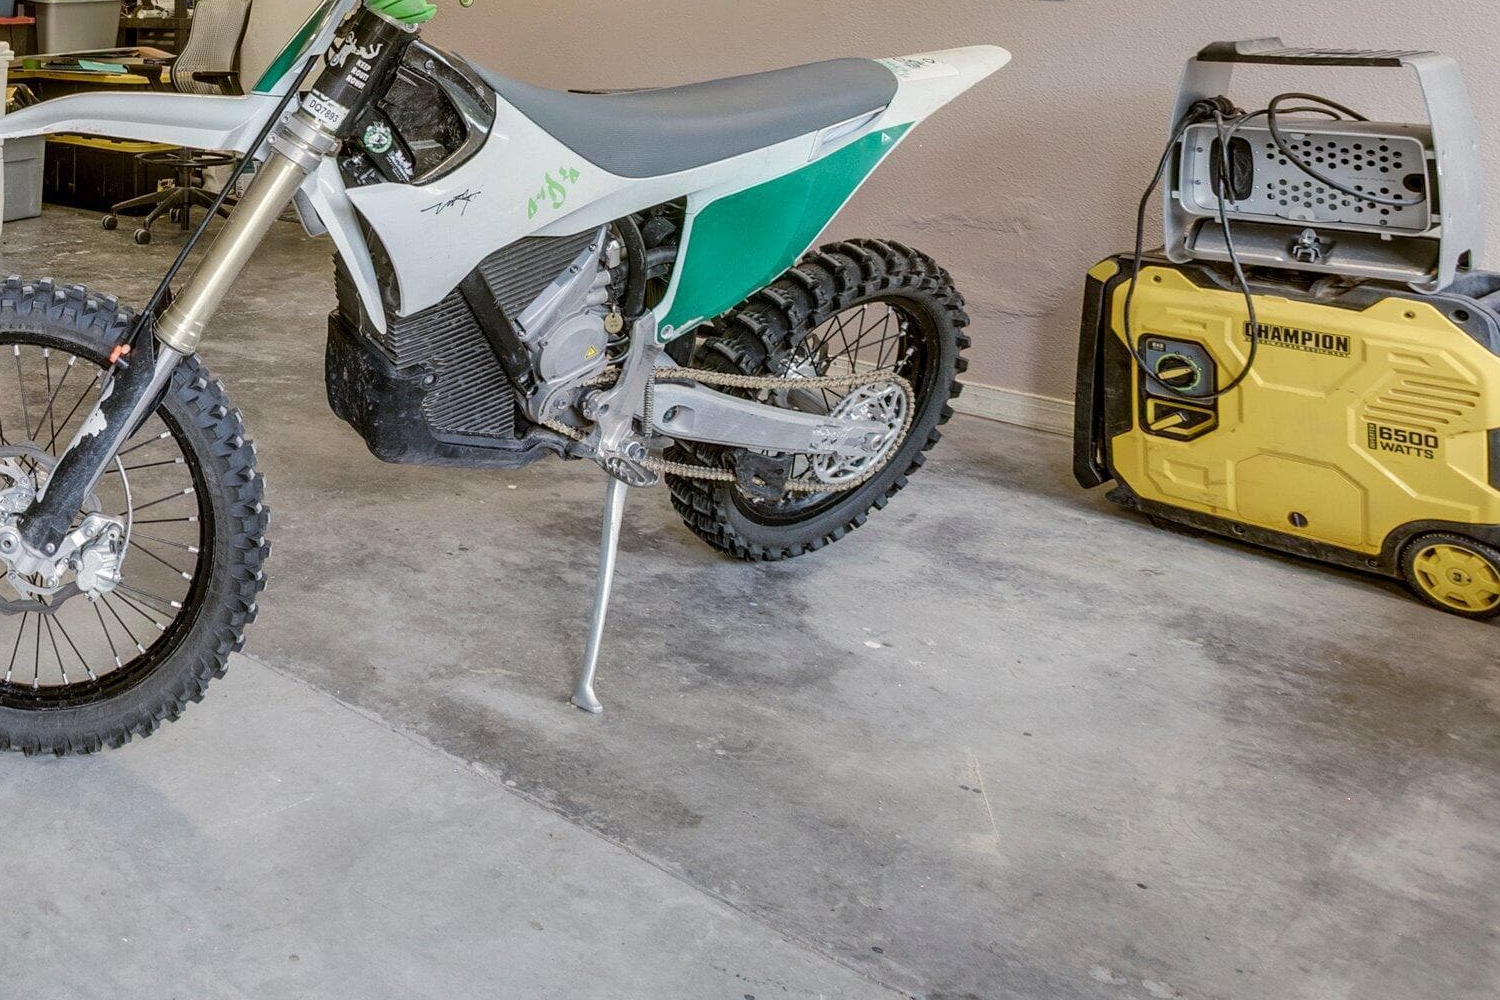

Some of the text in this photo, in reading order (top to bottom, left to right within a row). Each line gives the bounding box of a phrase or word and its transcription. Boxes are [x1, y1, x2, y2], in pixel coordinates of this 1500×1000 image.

[355, 60, 372, 72] KEEP
[309, 99, 339, 123] DQ7893
[1245, 322, 1349, 352] CHAMPION
[1379, 426, 1439, 449] 6500
[1380, 441, 1434, 459] WATTS
